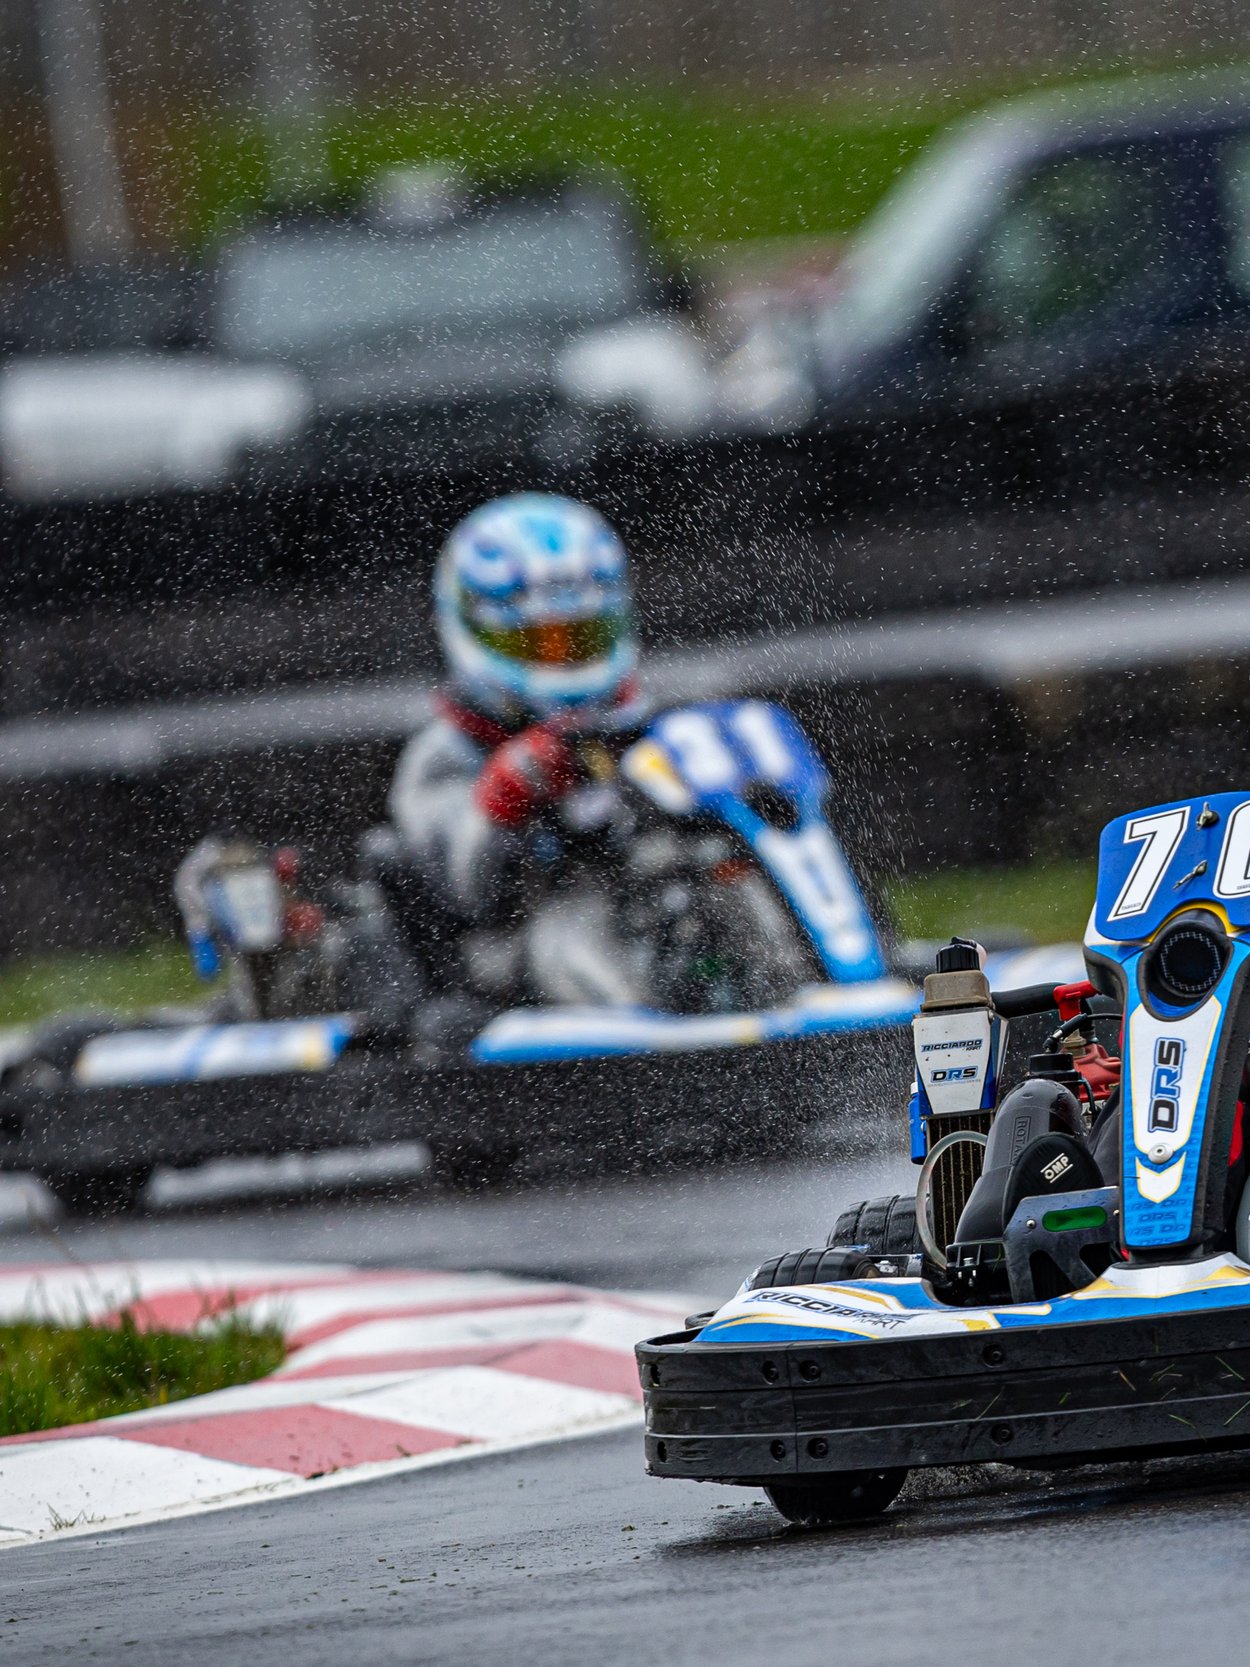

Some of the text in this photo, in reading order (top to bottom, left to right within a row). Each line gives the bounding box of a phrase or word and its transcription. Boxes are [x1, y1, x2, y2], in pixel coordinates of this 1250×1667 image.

[921, 1039, 983, 1052] RICCIARDO
[931, 1066, 978, 1083] DRS
[1149, 1037, 1184, 1132] DRS
[1044, 1156, 1069, 1180] OMP
